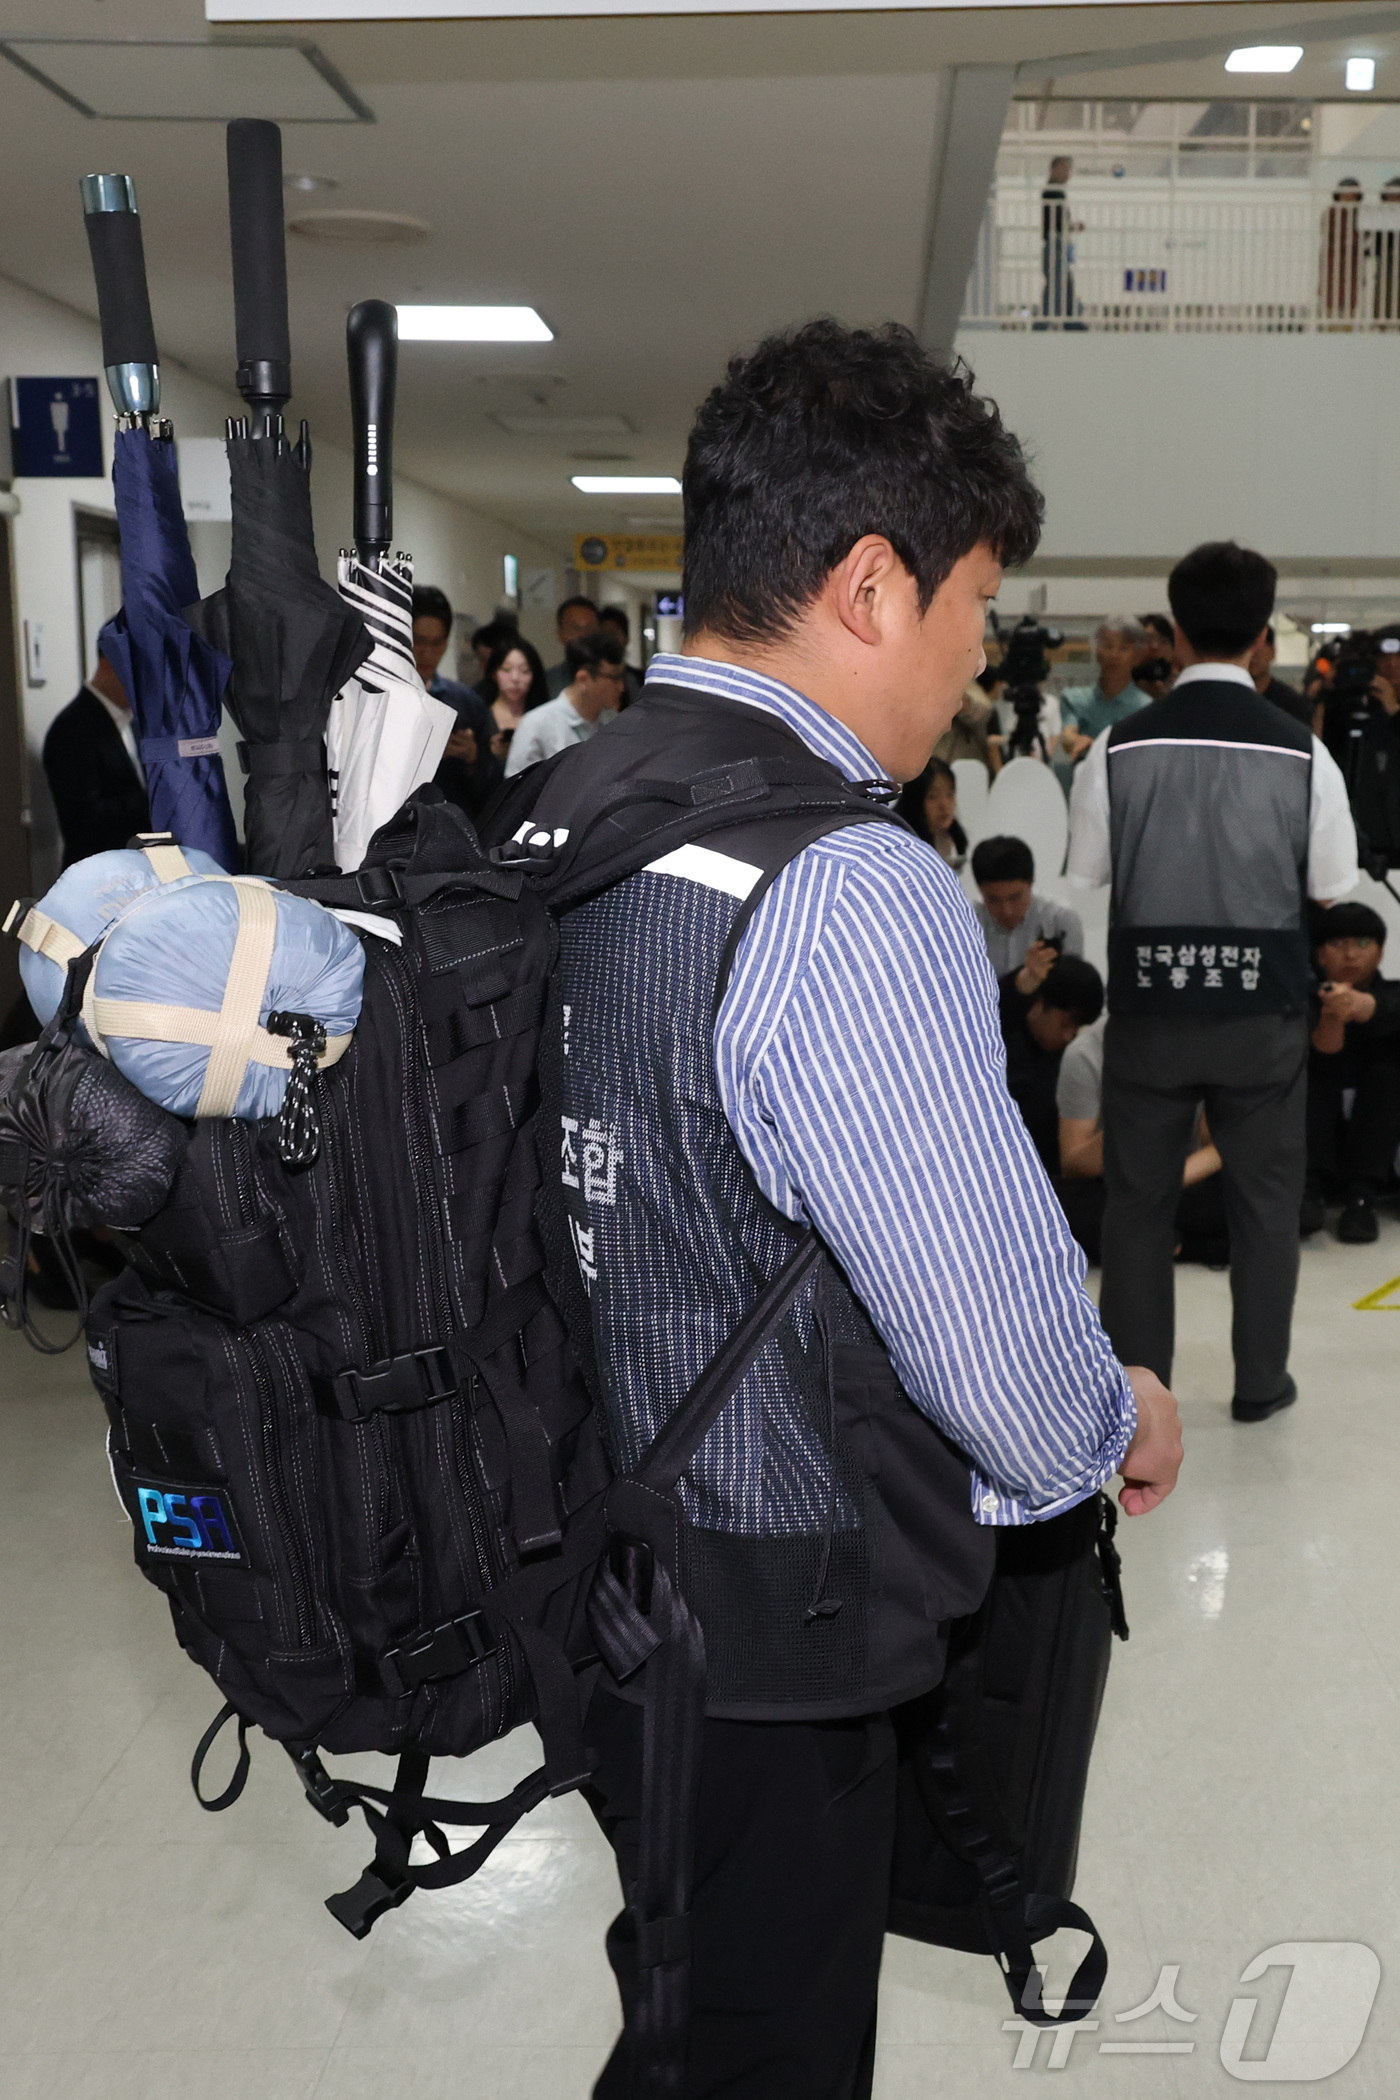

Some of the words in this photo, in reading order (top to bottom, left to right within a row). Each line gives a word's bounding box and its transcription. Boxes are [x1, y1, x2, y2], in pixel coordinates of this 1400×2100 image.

[1136, 944, 1262, 969] 전국삼성전자
[1137, 966, 1260, 991] 노동조합
[138, 1487, 236, 1551] PSA
